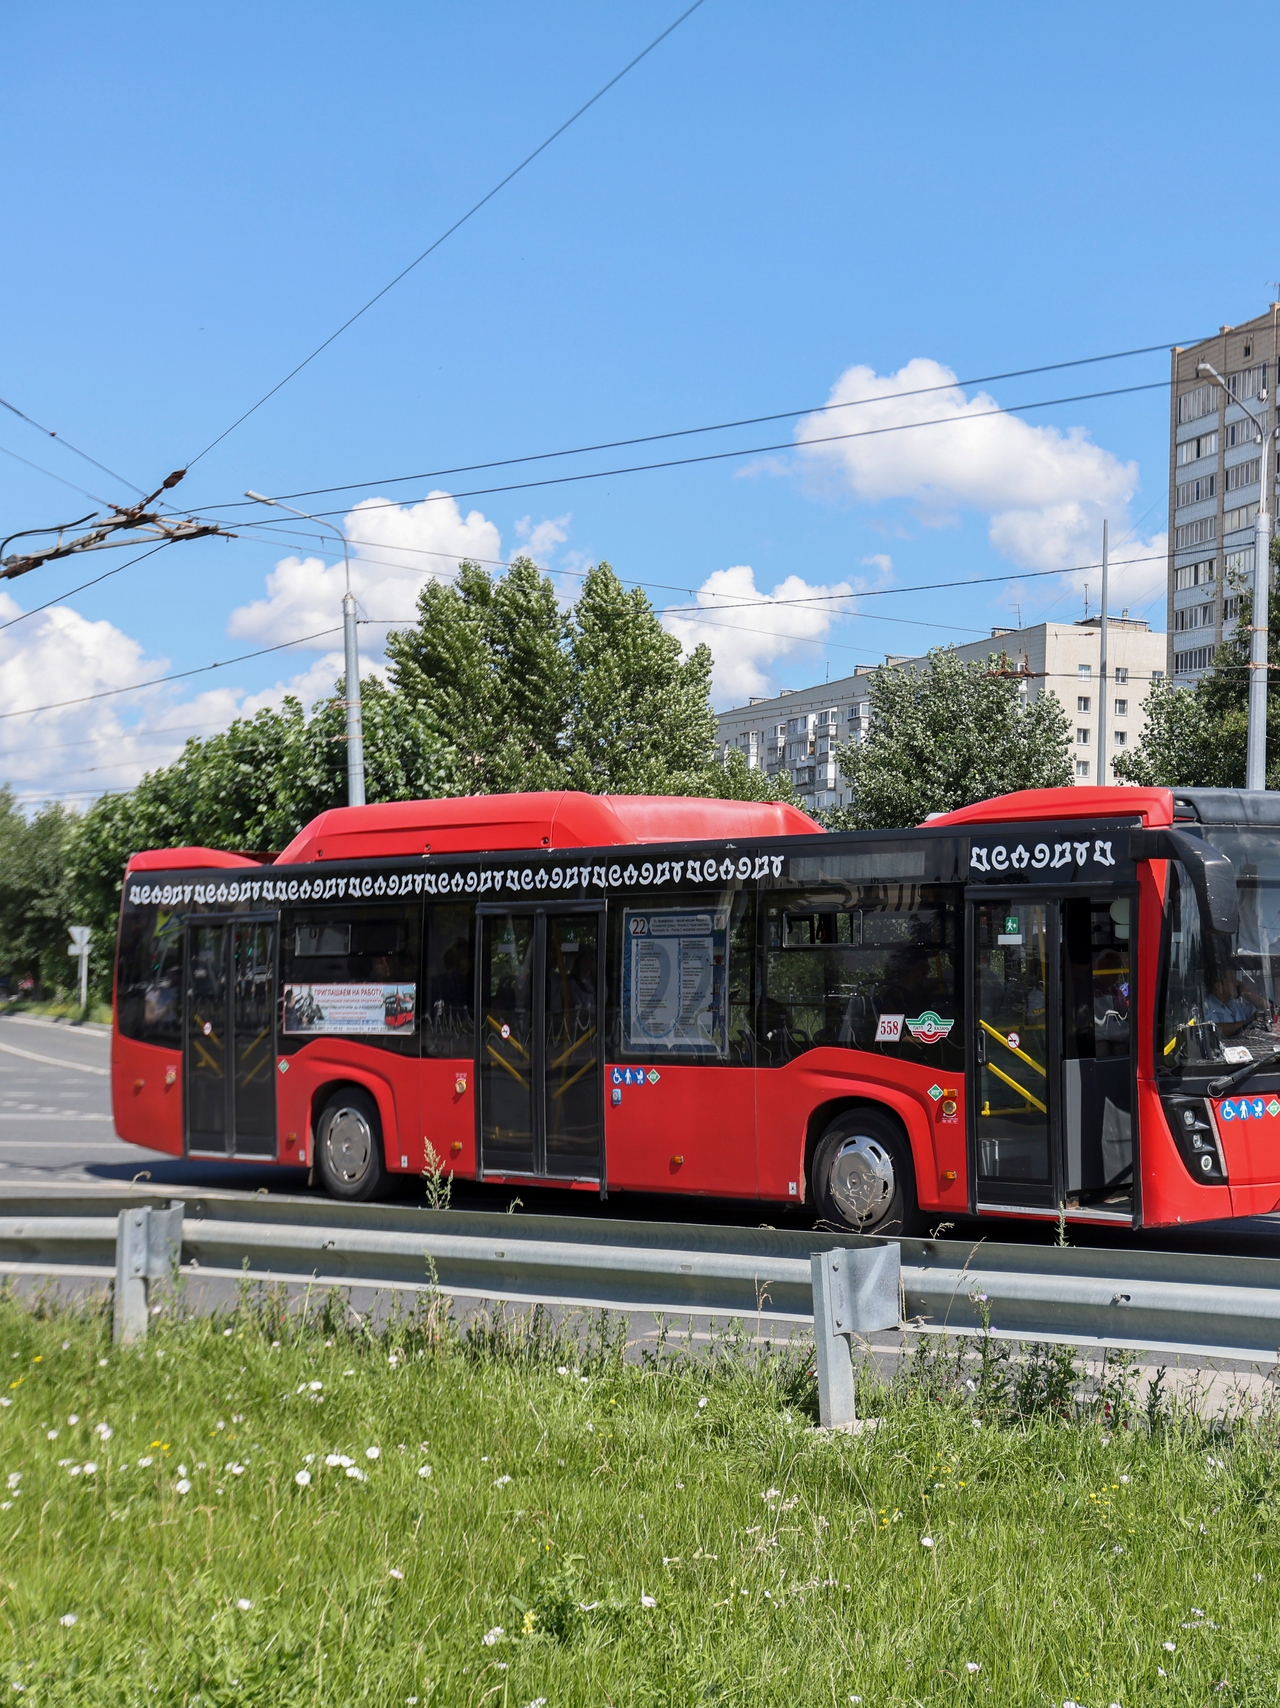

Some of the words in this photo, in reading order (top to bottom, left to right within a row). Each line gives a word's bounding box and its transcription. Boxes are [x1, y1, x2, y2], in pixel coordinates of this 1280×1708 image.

[632, 918, 646, 935] 22
[314, 988, 351, 997] ПРИГЛАШАЕМ
[352, 988, 360, 996] НА
[361, 988, 382, 996] РАБОТУ
[880, 1021, 899, 1035] 558
[927, 1023, 932, 1032] 2
